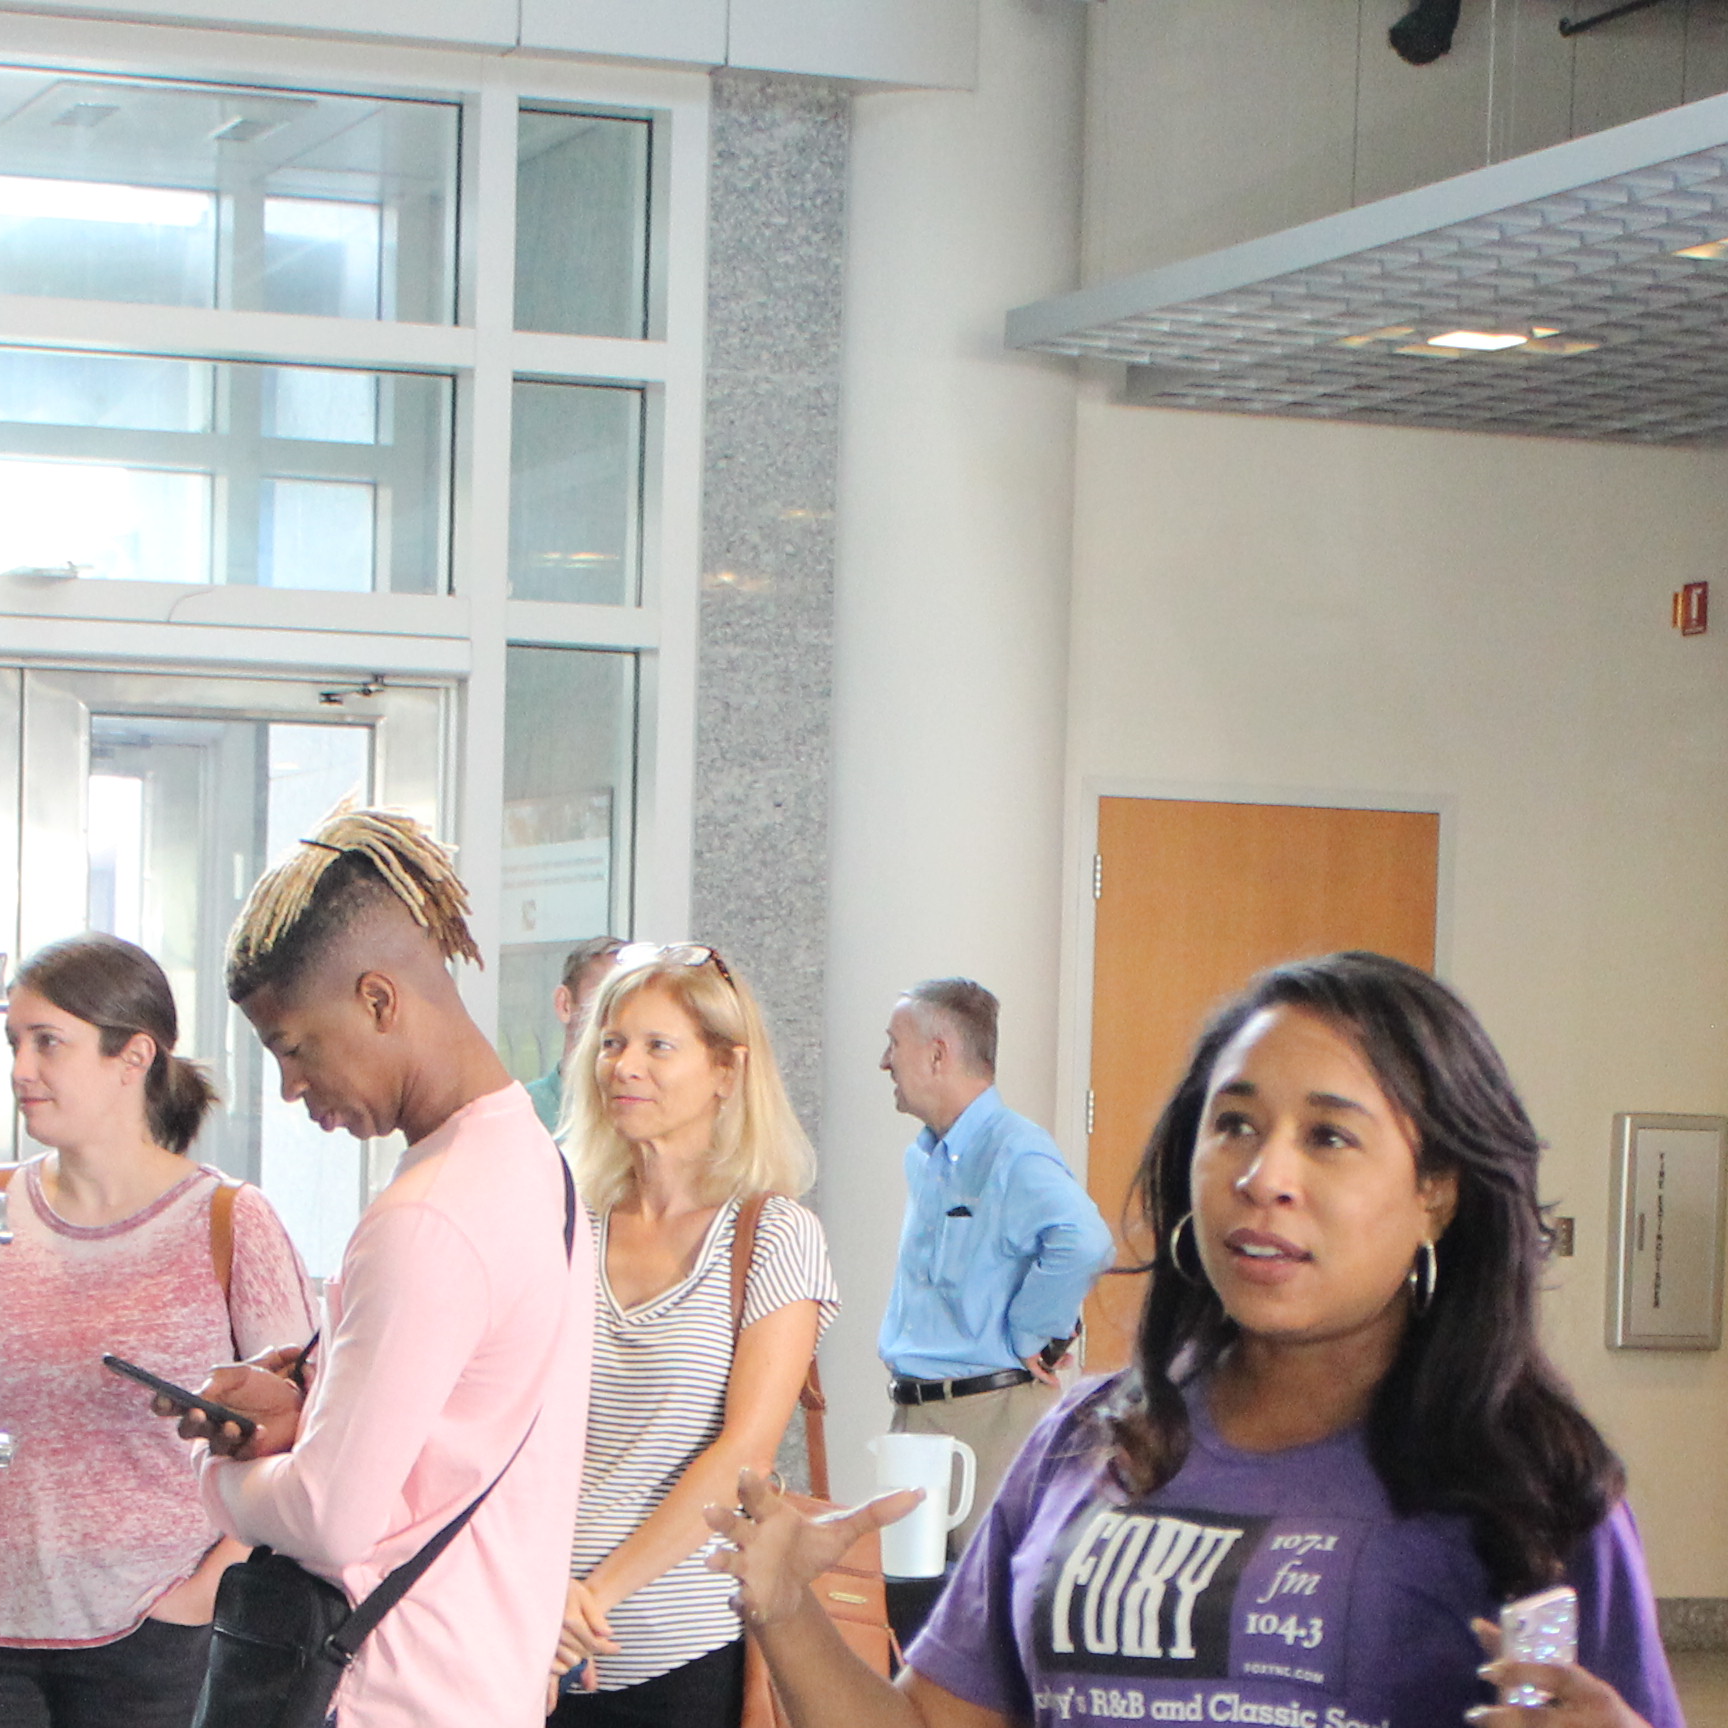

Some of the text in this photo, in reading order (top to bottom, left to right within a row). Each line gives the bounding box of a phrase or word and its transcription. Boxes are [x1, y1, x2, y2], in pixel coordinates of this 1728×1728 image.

[1270, 1532, 1339, 1555] 107.1
[1052, 1511, 1244, 1660] FOXY
[1257, 1560, 1321, 1604] fm
[1244, 1612, 1324, 1649] 104.3
[1089, 1688, 1146, 1721] R&B
[1151, 1693, 1203, 1722] and
